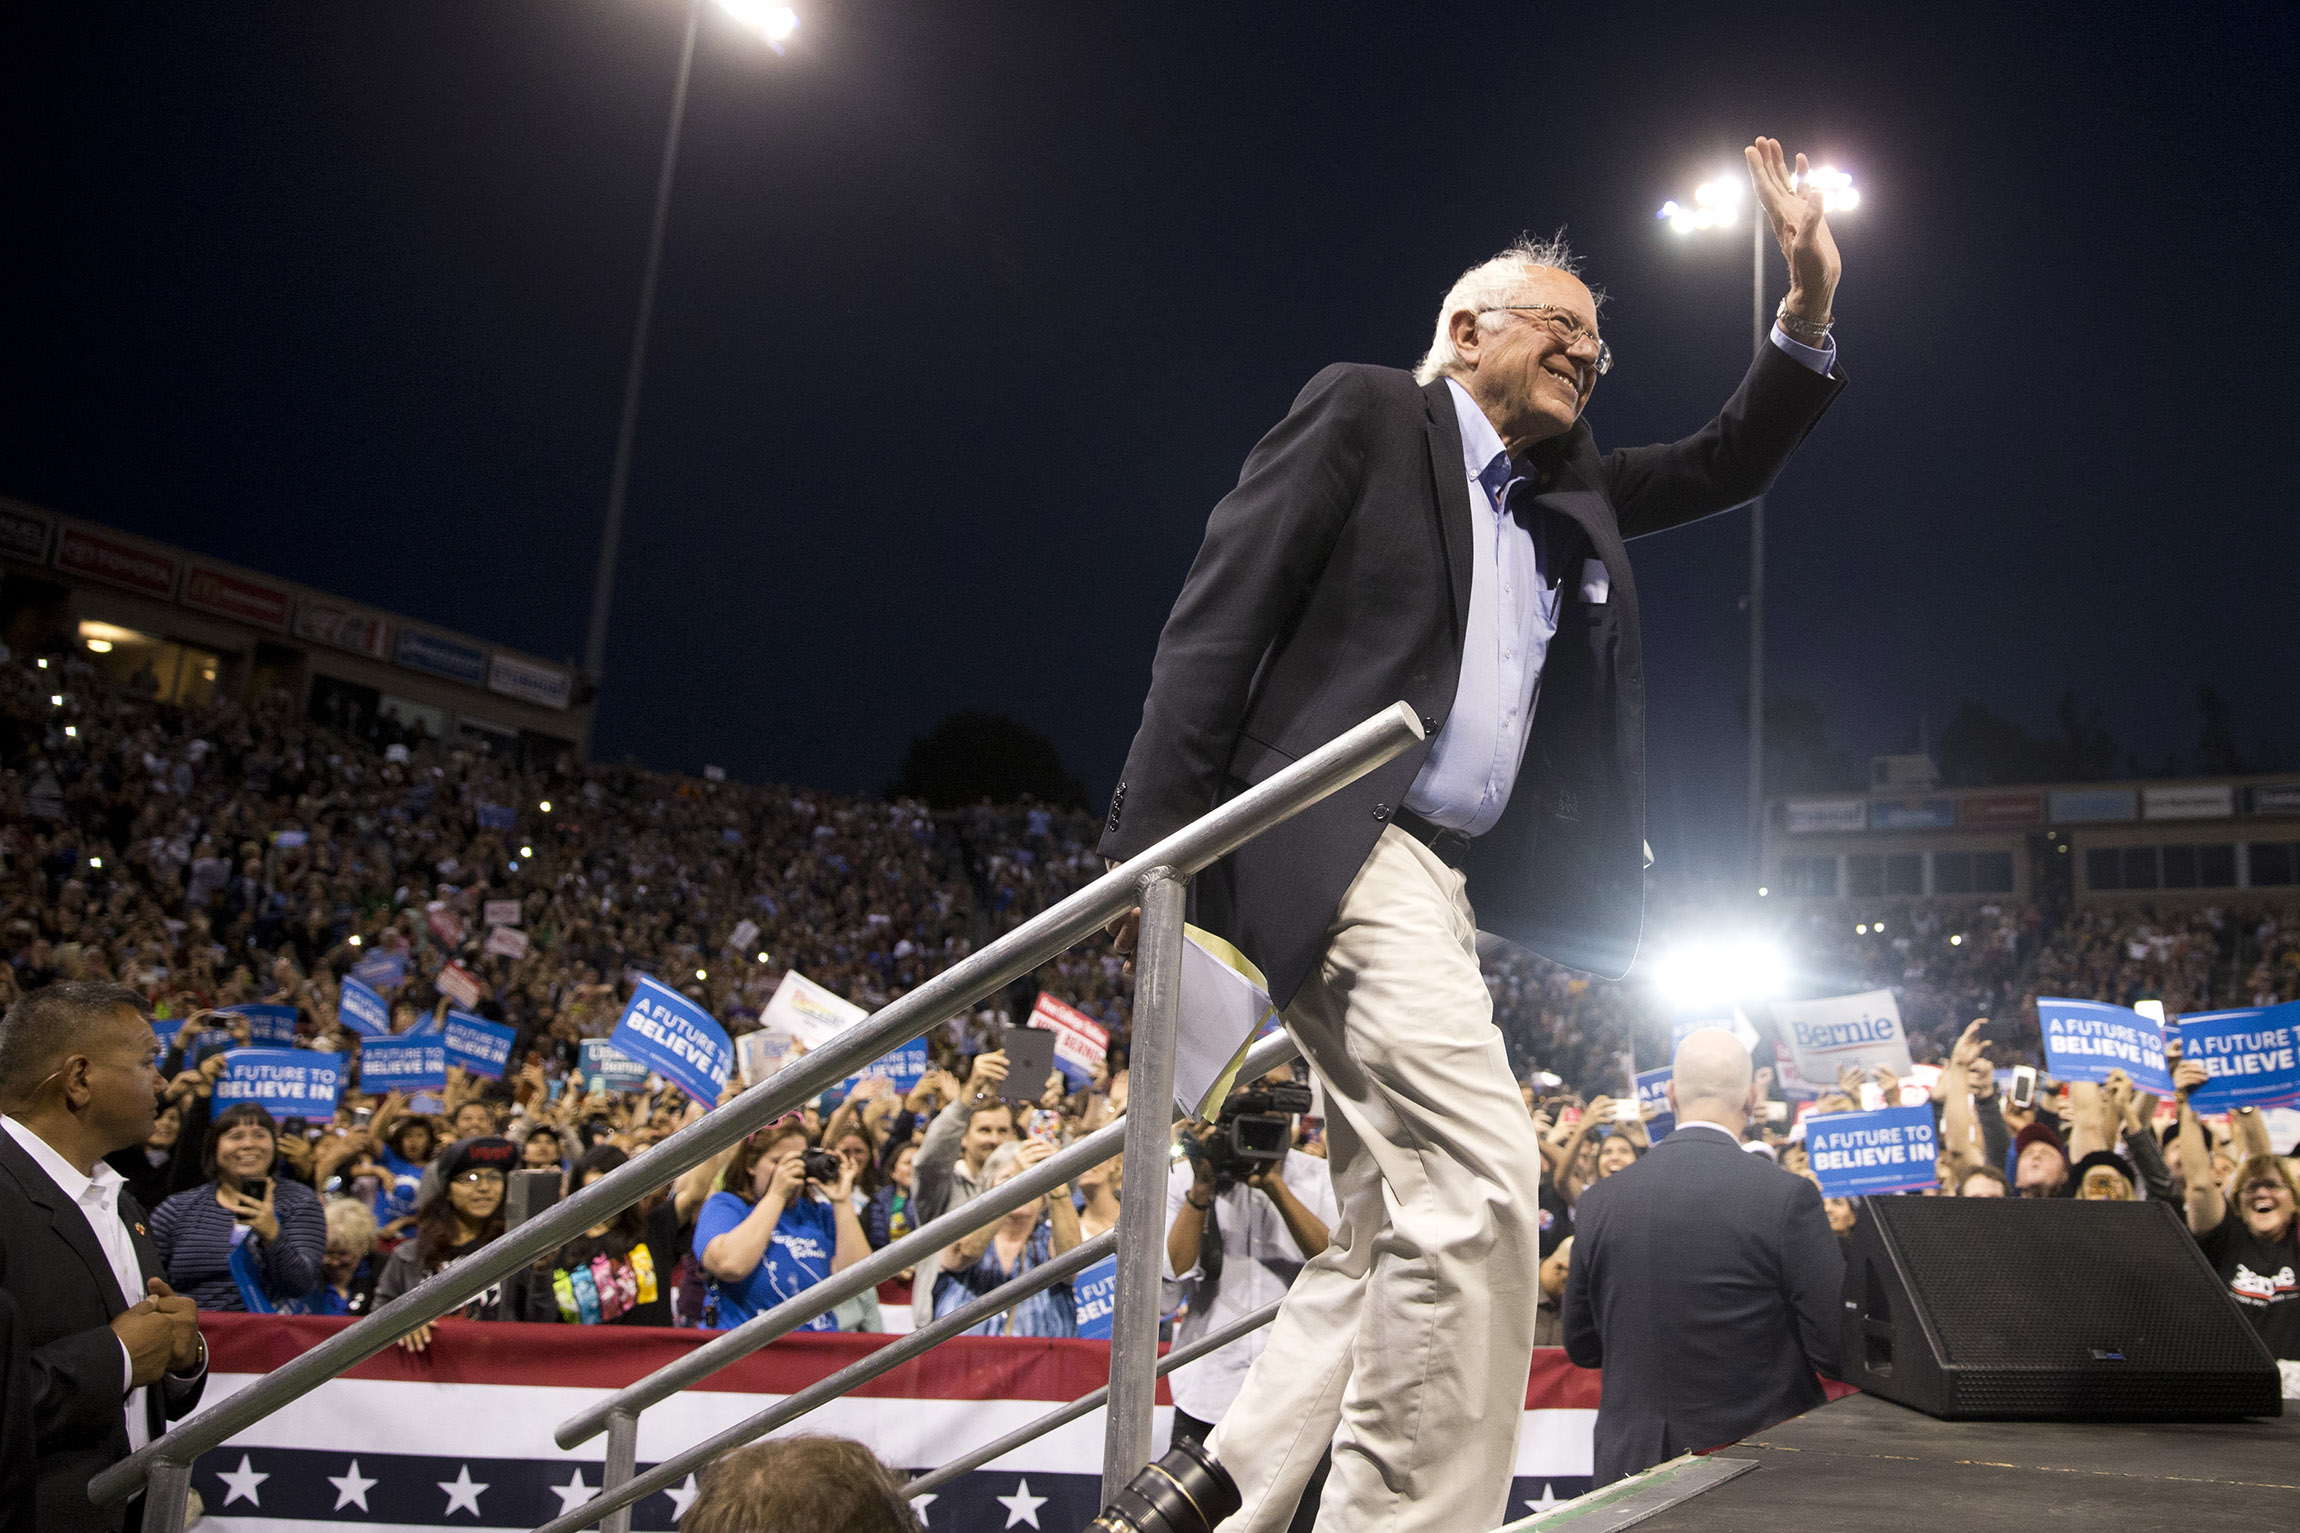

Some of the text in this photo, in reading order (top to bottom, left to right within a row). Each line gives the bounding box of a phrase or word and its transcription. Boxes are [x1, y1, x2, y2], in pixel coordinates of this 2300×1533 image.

[635, 998, 650, 1014] A
[651, 1005, 718, 1057] FUTURE
[1792, 1014, 1894, 1048] Bernie
[2050, 1018, 2162, 1051] A FUTURE TO
[425, 1047, 445, 1059] TO
[626, 1010, 712, 1074] BELIEVE
[2051, 1036, 2165, 1071] BELIEVE IN
[2188, 1039, 2203, 1056] A
[2204, 1028, 2290, 1054] FUTURE
[363, 1060, 422, 1075] BELIEVE
[425, 1059, 444, 1073] IN
[908, 1050, 926, 1064] TO
[908, 1063, 926, 1076] IN
[234, 1065, 306, 1082] FUTURE
[310, 1068, 336, 1085] TO
[217, 1081, 334, 1100] BELIEVE IN
[1814, 1124, 1932, 1150] A FUTURE TO
[1814, 1142, 1935, 1171] BELIEVE IN
[1081, 1275, 1115, 1302] FUT
